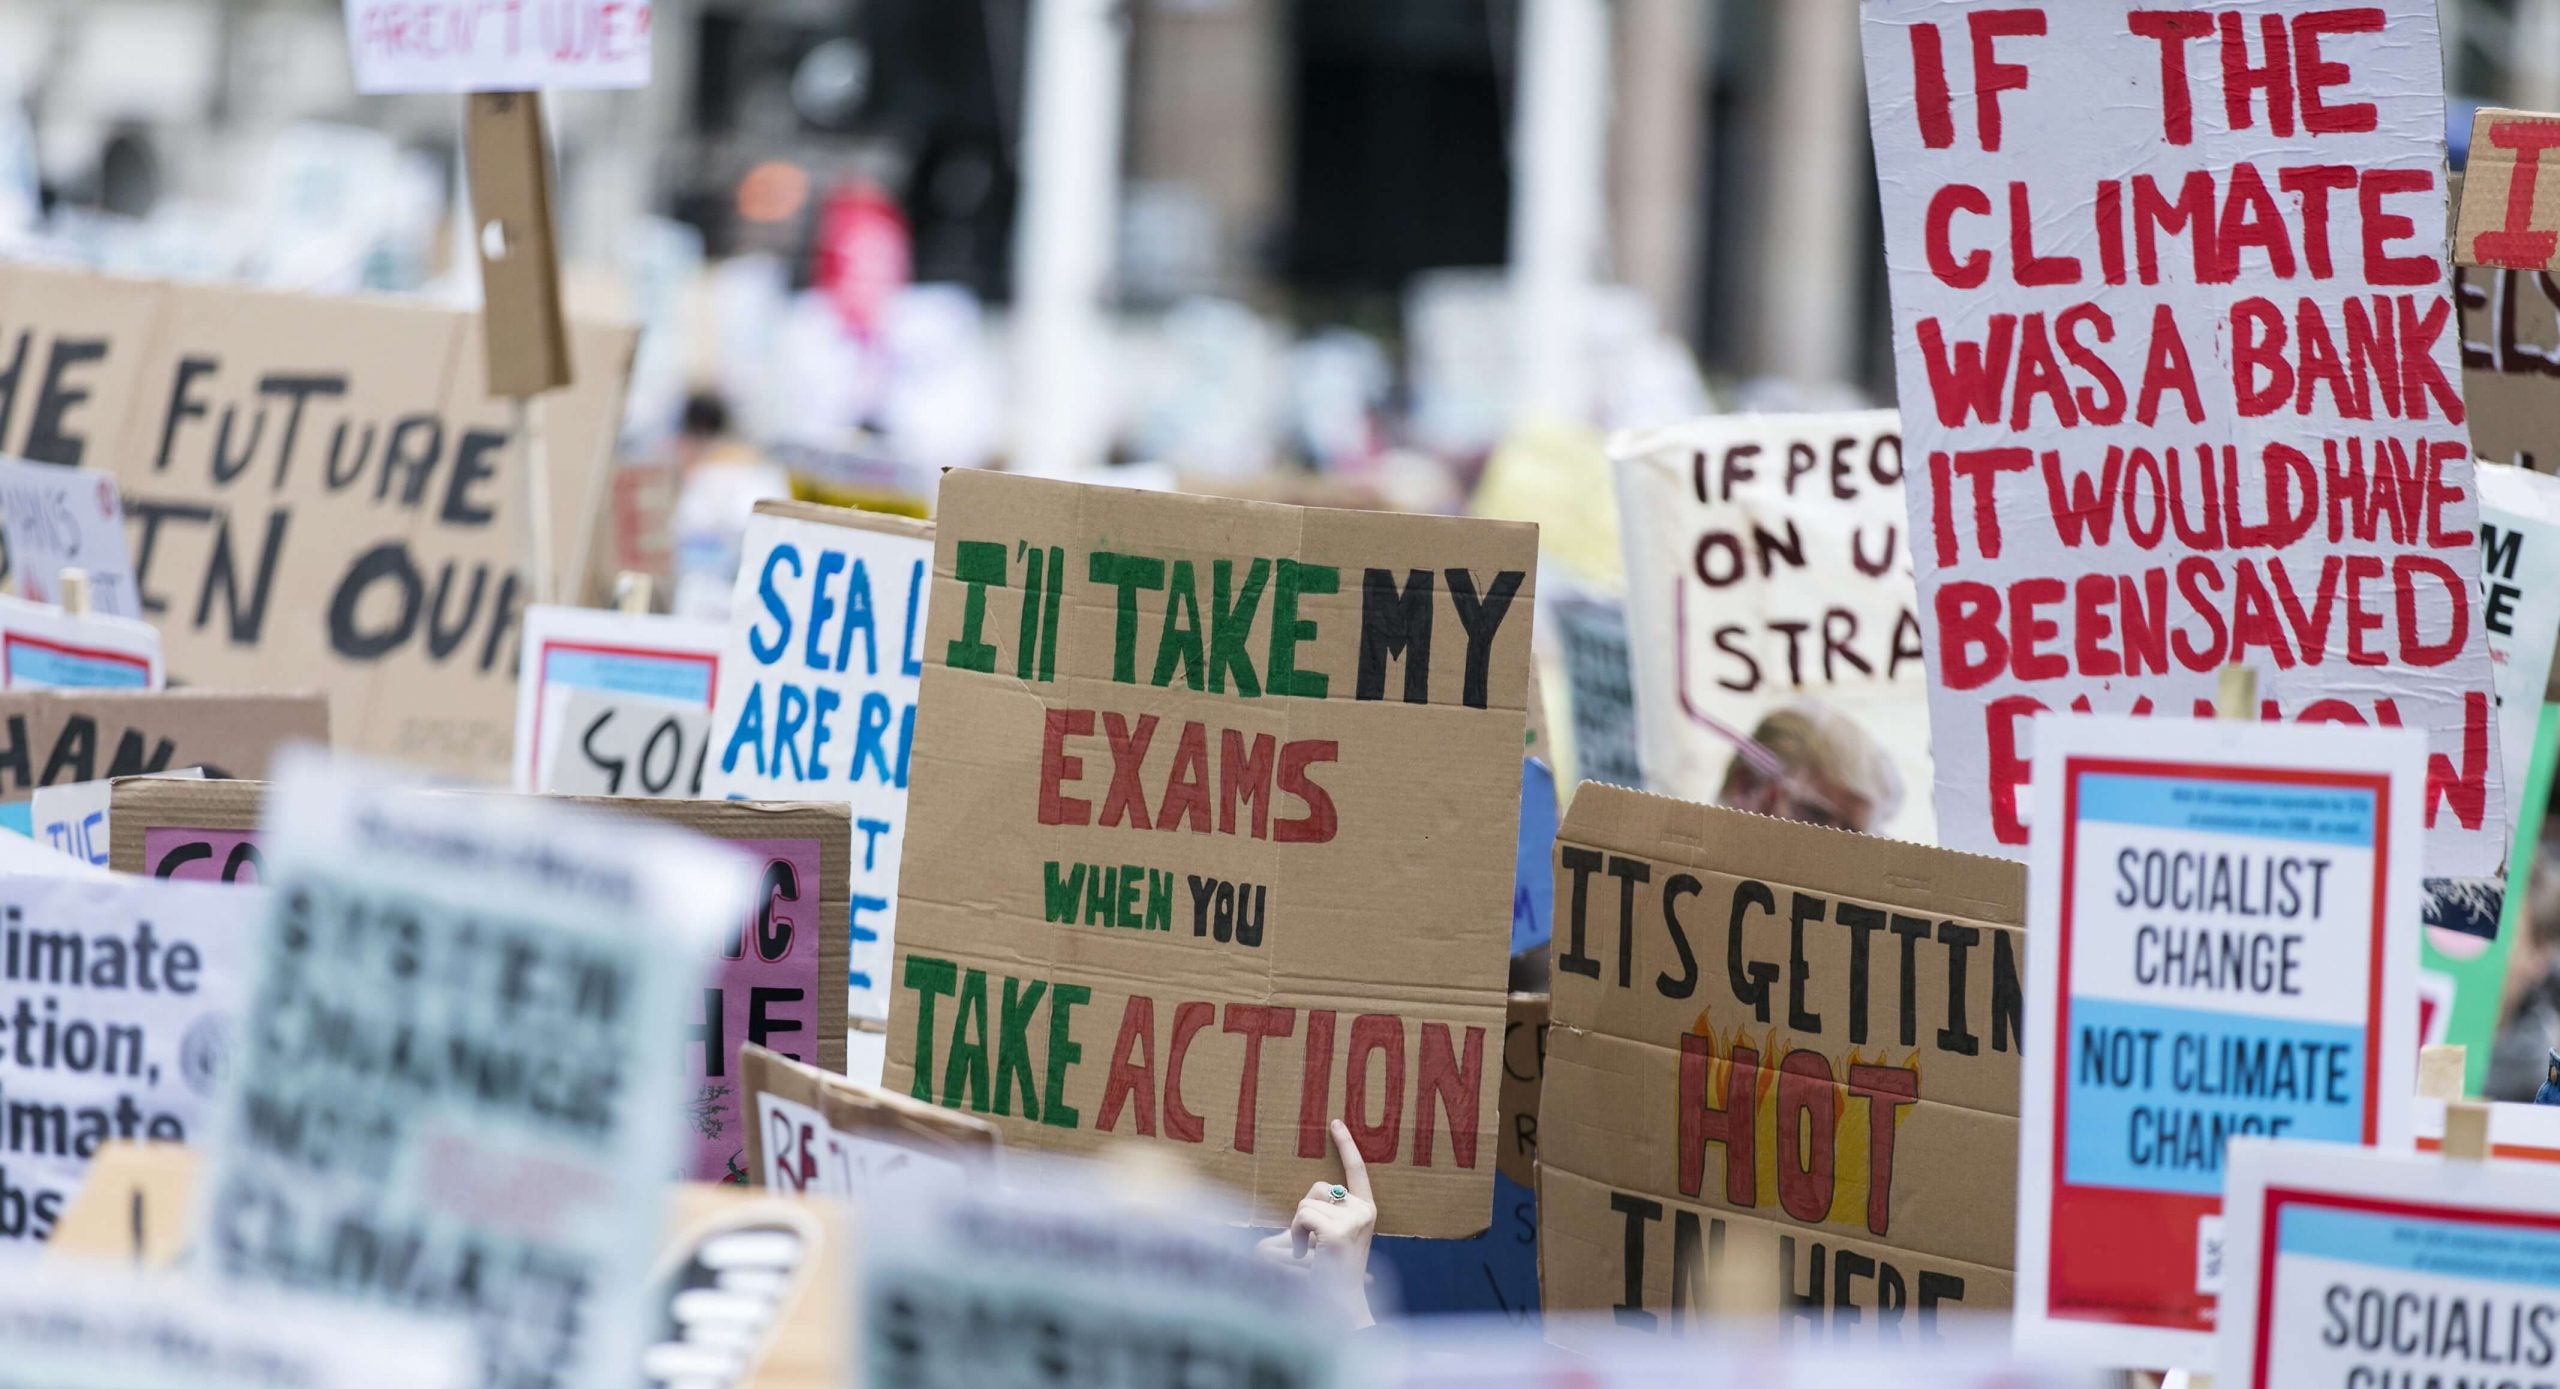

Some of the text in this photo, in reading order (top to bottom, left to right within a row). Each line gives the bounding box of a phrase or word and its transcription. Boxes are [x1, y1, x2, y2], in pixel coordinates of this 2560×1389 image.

[1910, 8, 2386, 151] IF THE
[1925, 163, 2441, 288] CLIMATE
[1916, 295, 2465, 431] WAS A BANK
[154, 354, 514, 528] FUTURE
[1693, 434, 1904, 503] IF PEO
[1930, 437, 2475, 567] IT WOULD HAVE
[121, 495, 290, 645] IN
[750, 544, 878, 674] SEA
[1694, 520, 1808, 588] ON
[1089, 551, 1341, 699] TAKE
[1355, 567, 1526, 709] MY
[1713, 606, 1921, 692] STRA
[1935, 555, 2469, 690] BEEN SAVED
[0, 712, 236, 789] HAN
[722, 681, 840, 781] ARE
[1037, 707, 1339, 843] EXAMS
[1043, 860, 1267, 947] WHEN YOU
[2116, 846, 2332, 921] SOCIALIST
[1559, 846, 2026, 1057] ITS GETTIN
[2134, 923, 2303, 996] CHANGE
[0, 997, 160, 1089] tion,
[904, 953, 1485, 1169] TAKE ACTION
[2079, 1024, 2352, 1105] NOT CLIMATE
[1679, 1030, 1919, 1237] HOT
[1611, 1191, 1726, 1340] IN
[2322, 1283, 2557, 1368] SOCIALIS
